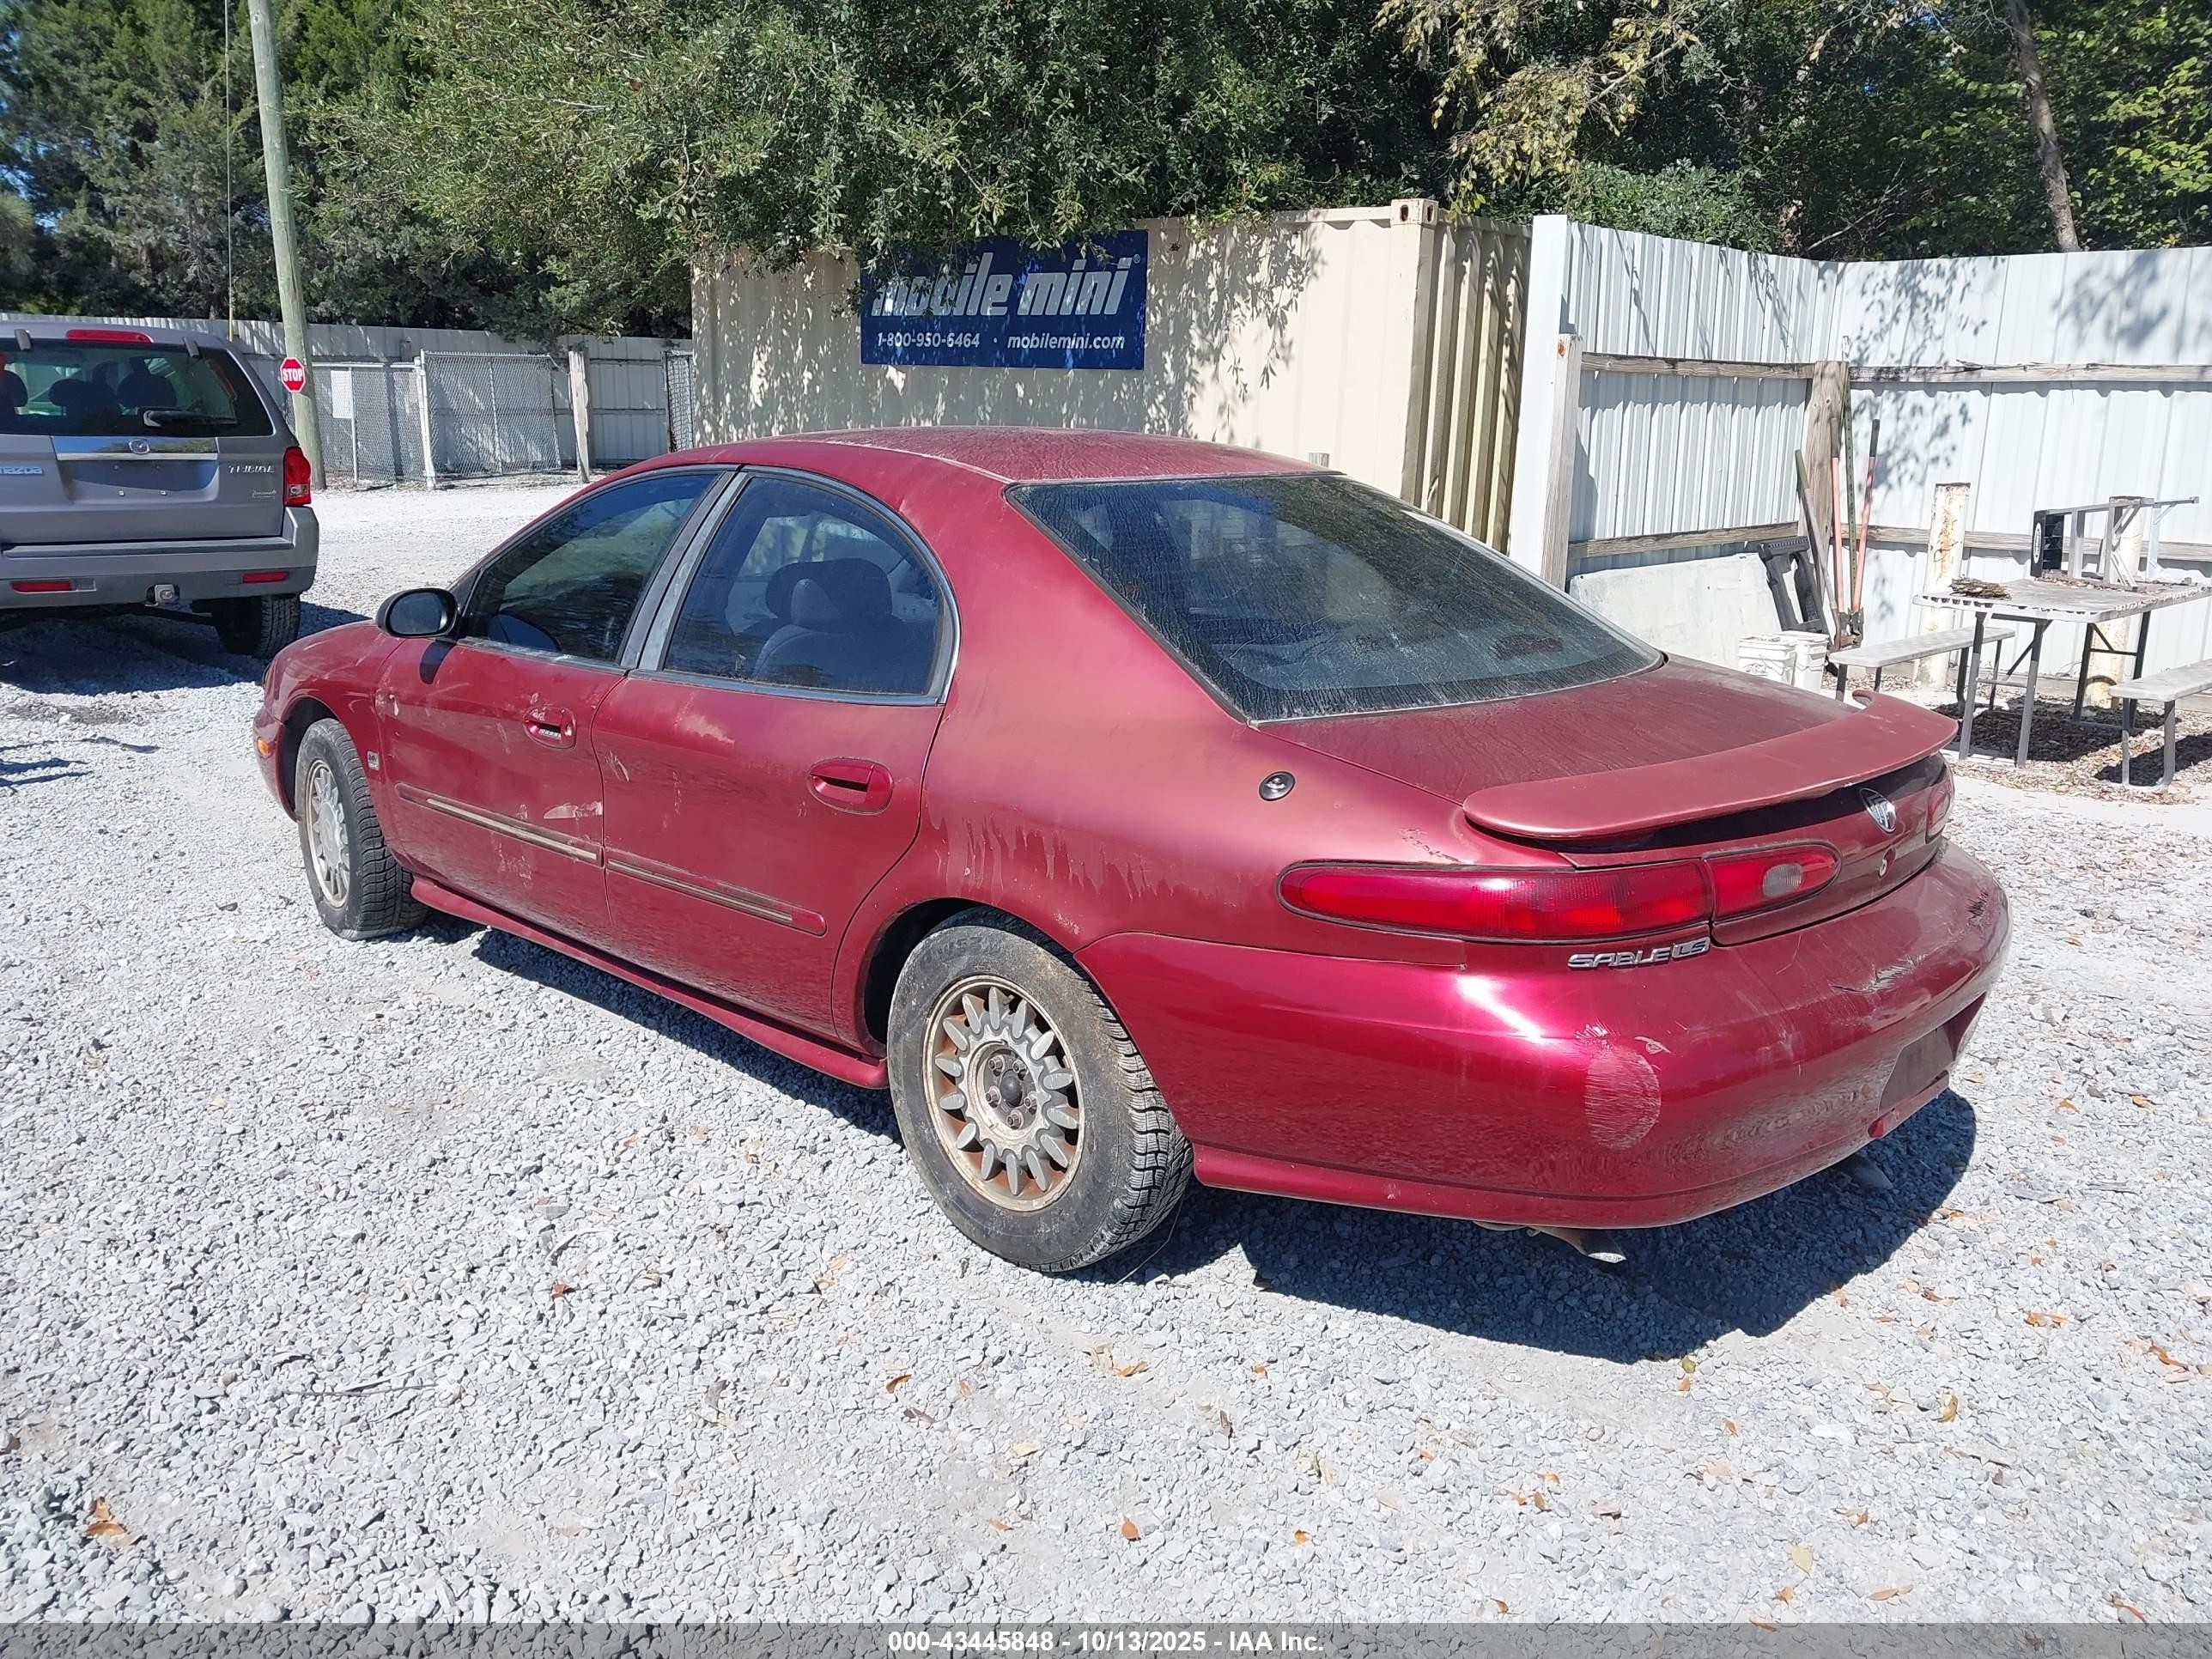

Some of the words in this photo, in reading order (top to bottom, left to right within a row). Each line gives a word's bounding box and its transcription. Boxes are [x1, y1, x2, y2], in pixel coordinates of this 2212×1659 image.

[871, 252, 1013, 316] mobile
[877, 332, 981, 348] 1-800-950-6464
[1006, 332, 1125, 349] mobilemini.com
[282, 368, 304, 382] STOP
[1567, 946, 1672, 969] SABLE
[1671, 937, 1711, 959] LS
